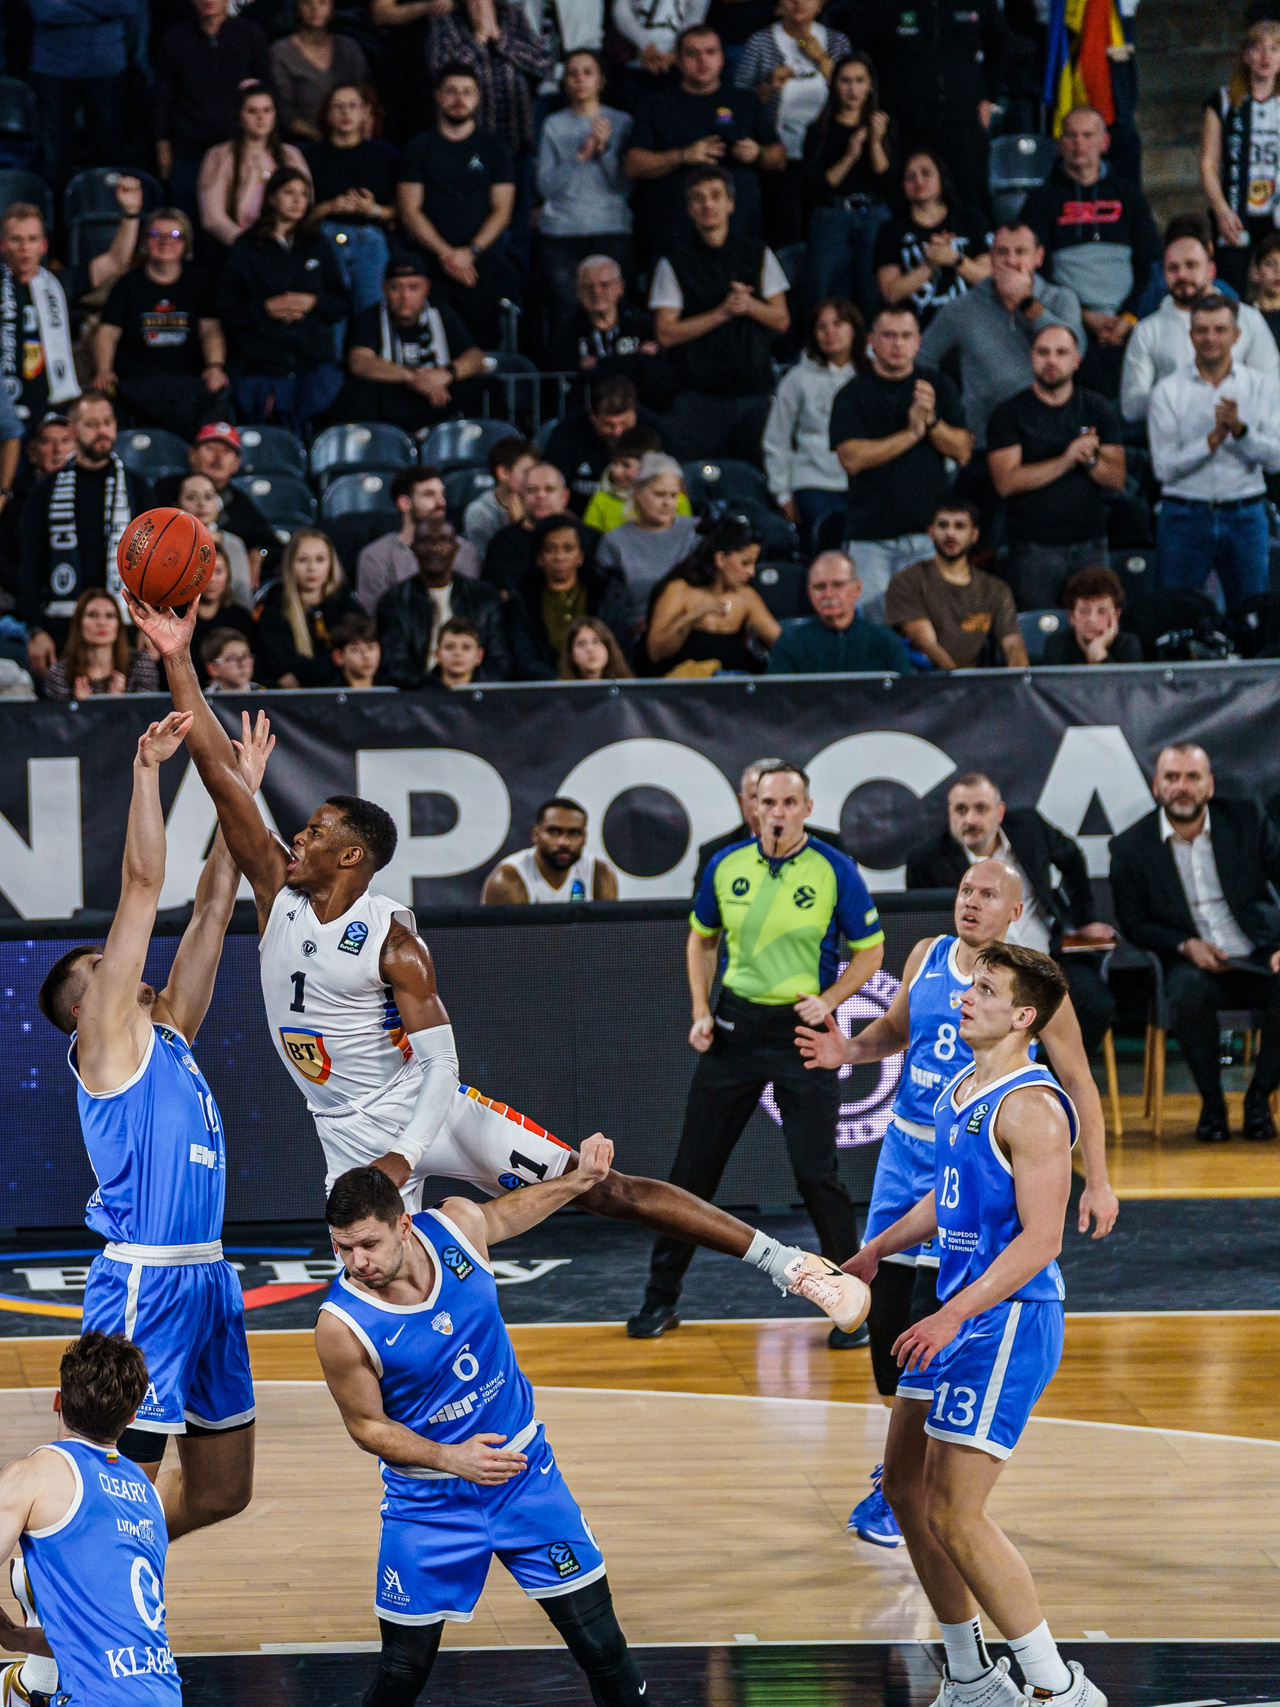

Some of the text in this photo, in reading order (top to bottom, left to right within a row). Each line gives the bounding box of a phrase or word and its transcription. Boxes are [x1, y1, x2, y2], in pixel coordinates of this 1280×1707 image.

[124, 518, 153, 572] LEGACY
[339, 943, 359, 954] EuroCup
[289, 970, 307, 1013] 1
[286, 1041, 316, 1061] BT
[933, 1023, 957, 1061] 8
[509, 1149, 549, 1182] 1
[939, 1165, 960, 1209] 13
[451, 1343, 480, 1382] 6
[932, 1381, 978, 1427] 13
[98, 1472, 148, 1504] CLEARY
[130, 1556, 167, 1631] 0
